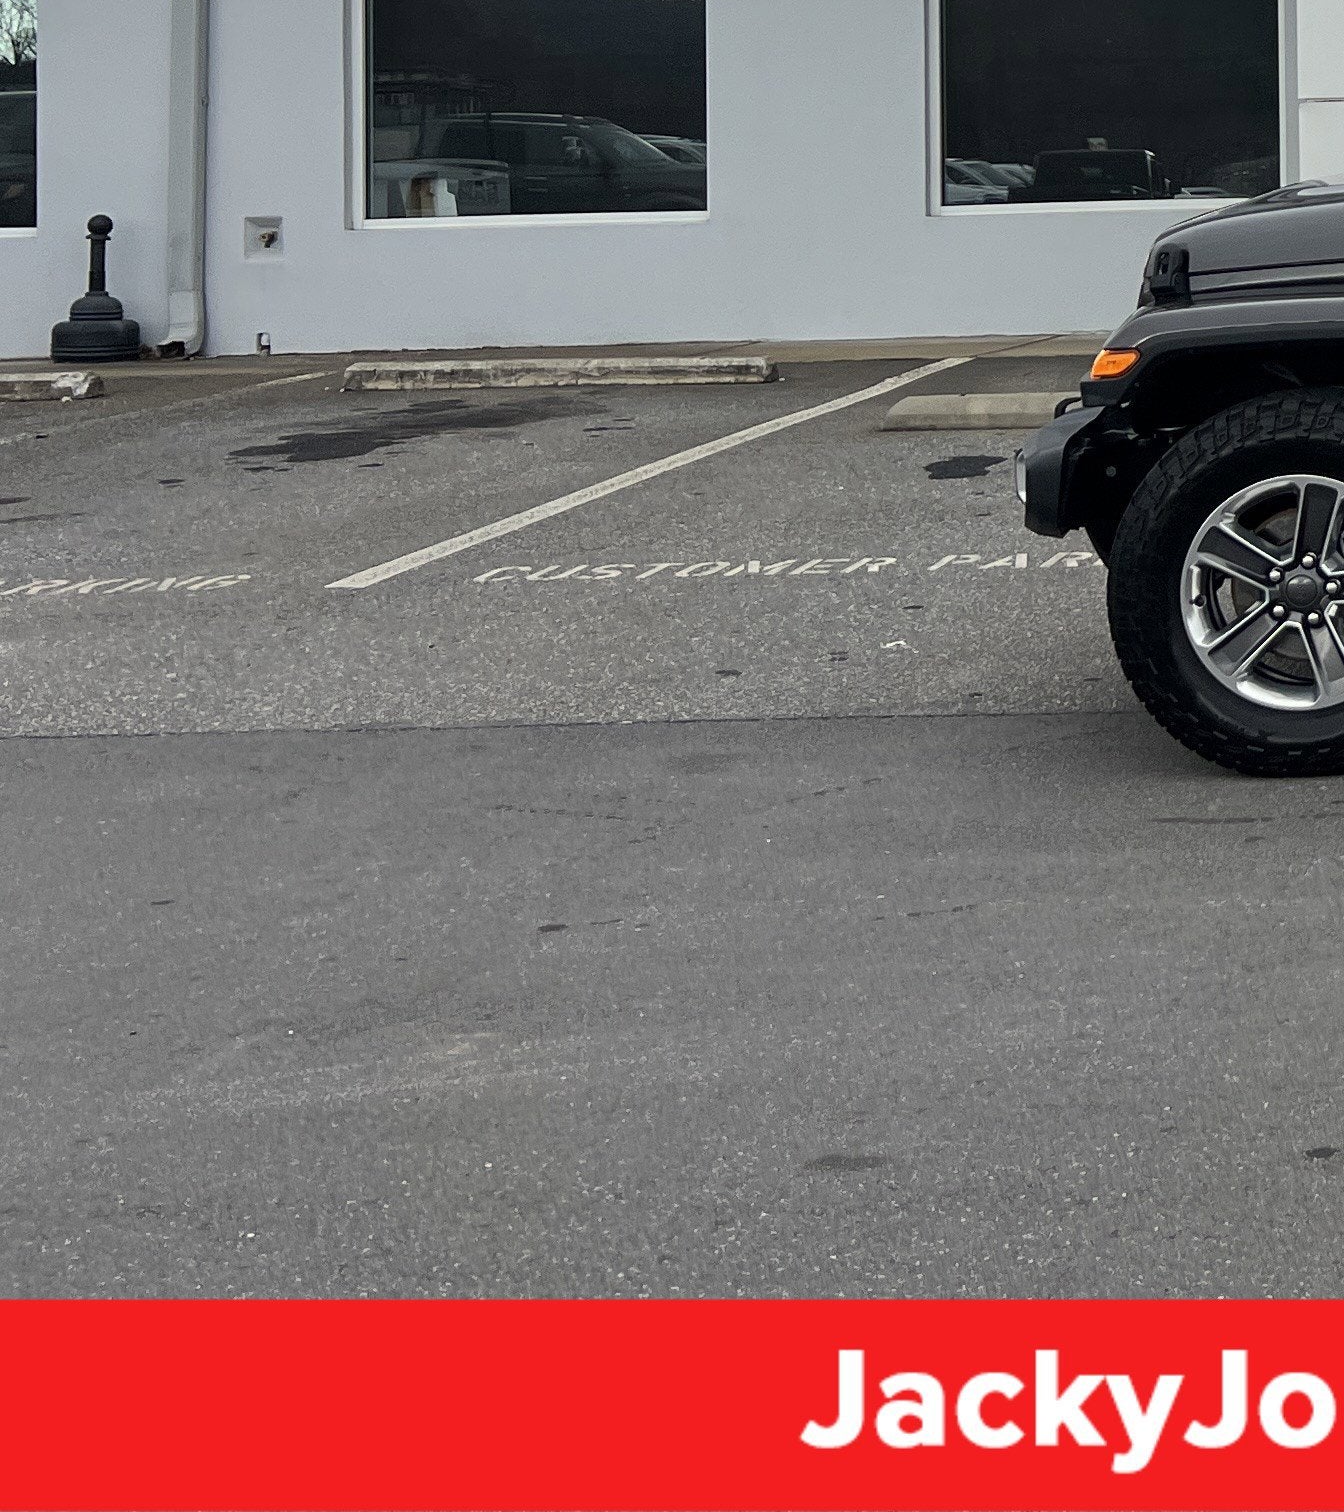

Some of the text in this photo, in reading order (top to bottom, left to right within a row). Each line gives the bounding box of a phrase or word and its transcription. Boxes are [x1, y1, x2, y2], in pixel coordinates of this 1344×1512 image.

[473, 552, 1104, 584] CUSTOMER PAR
[0, 574, 252, 595] RKING
